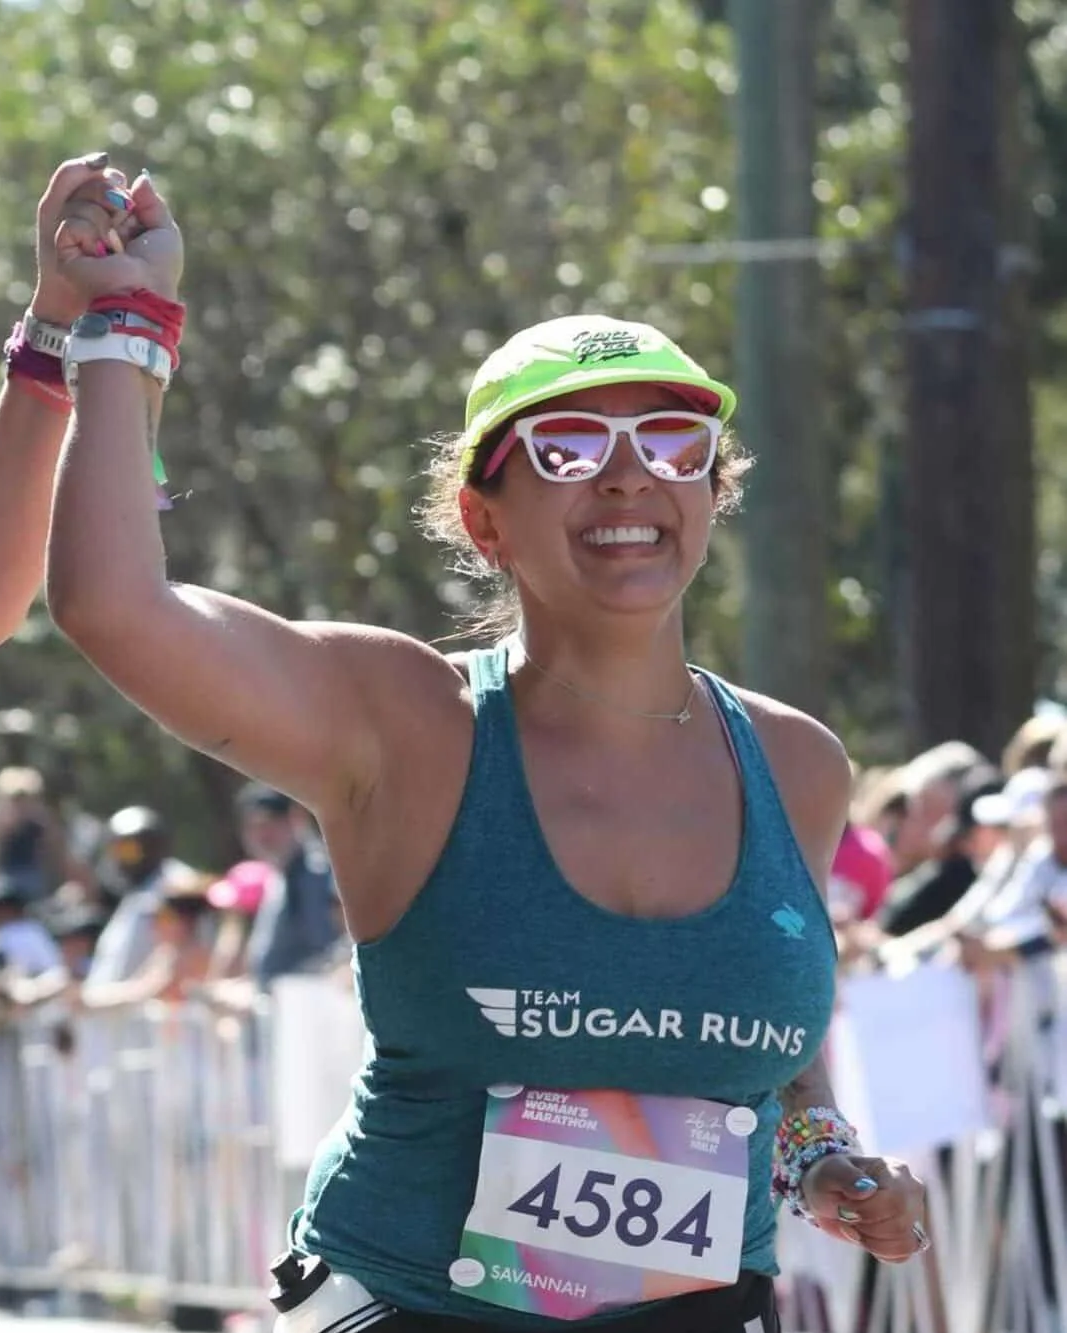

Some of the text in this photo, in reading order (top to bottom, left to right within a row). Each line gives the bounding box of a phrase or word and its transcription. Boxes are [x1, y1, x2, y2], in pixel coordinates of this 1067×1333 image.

[521, 990, 581, 1005] TEAM
[521, 1008, 806, 1057] SUGAR RUNS
[527, 1090, 569, 1104] EVERY
[525, 1099, 589, 1119] WOMAN'S
[522, 1109, 598, 1131] MARATHON
[690, 1129, 721, 1145] TEAM
[506, 1162, 713, 1257] 4584
[491, 1265, 587, 1298] SAVANNAH
